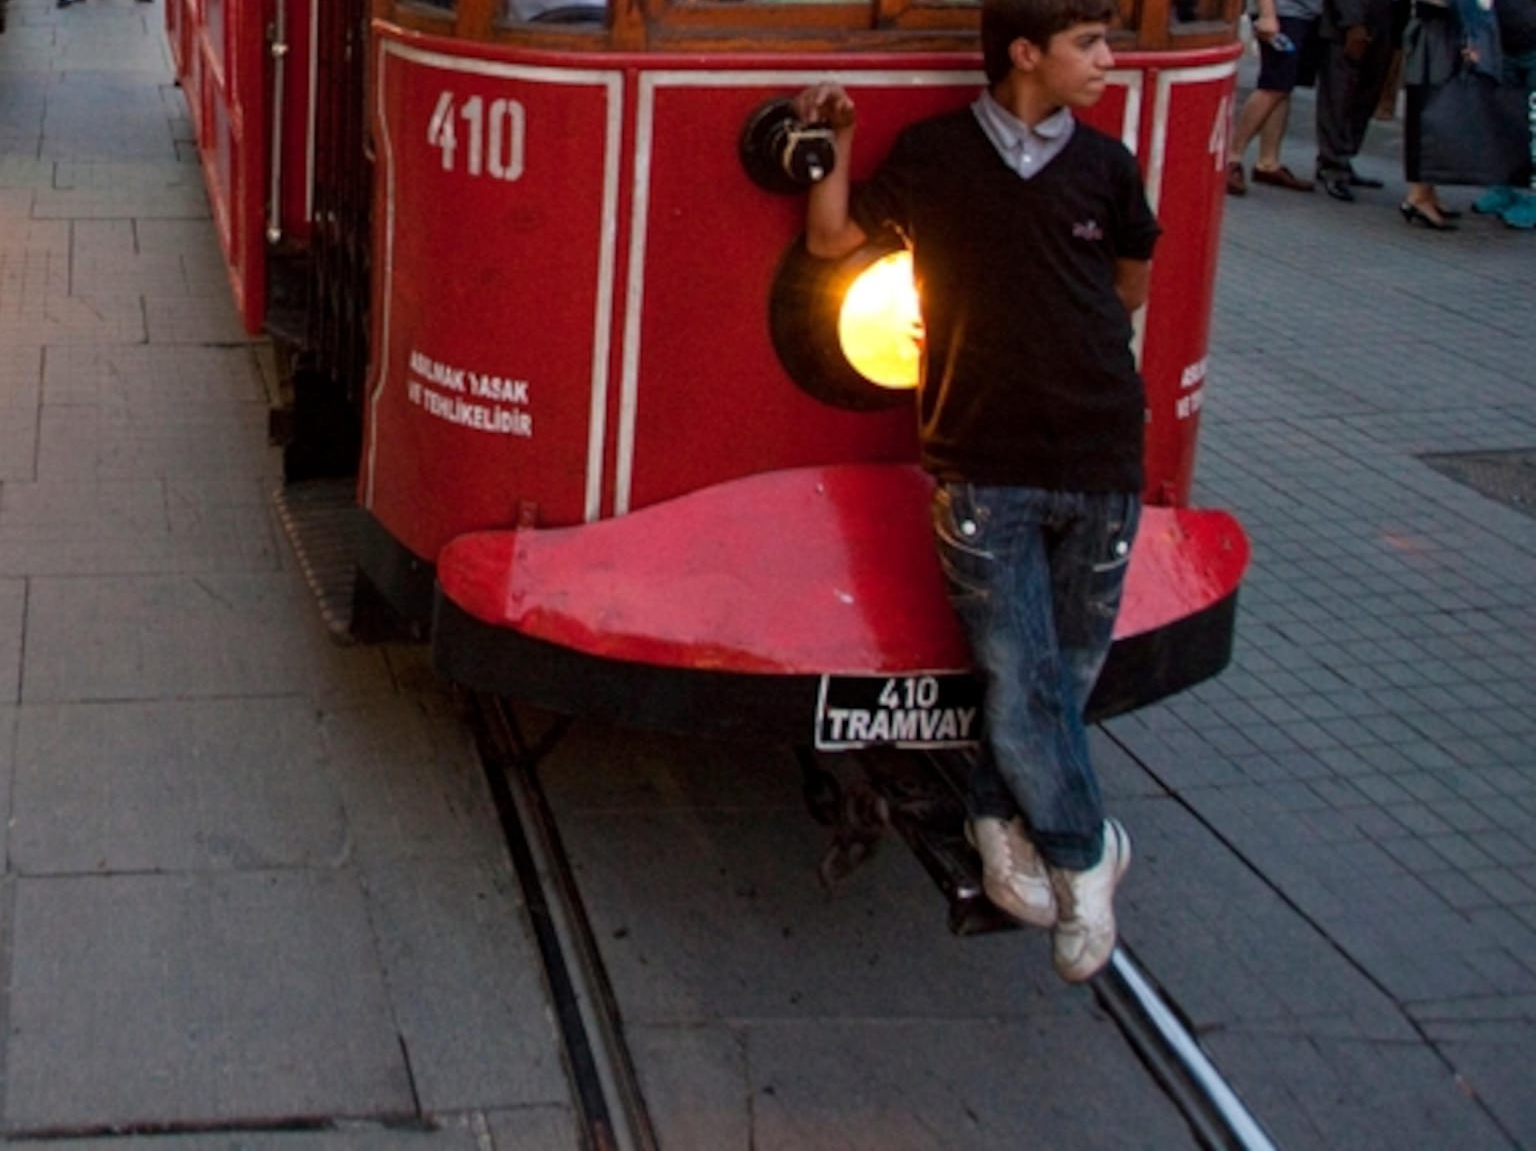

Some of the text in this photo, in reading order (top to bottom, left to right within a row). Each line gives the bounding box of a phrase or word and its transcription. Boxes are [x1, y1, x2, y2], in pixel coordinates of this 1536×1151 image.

[427, 90, 527, 181] 410
[409, 350, 529, 405] ASILMAK YASAK
[424, 387, 533, 439] TEHLİKELİDİR
[878, 676, 938, 709] 410
[828, 708, 976, 740] TRAMVAY
